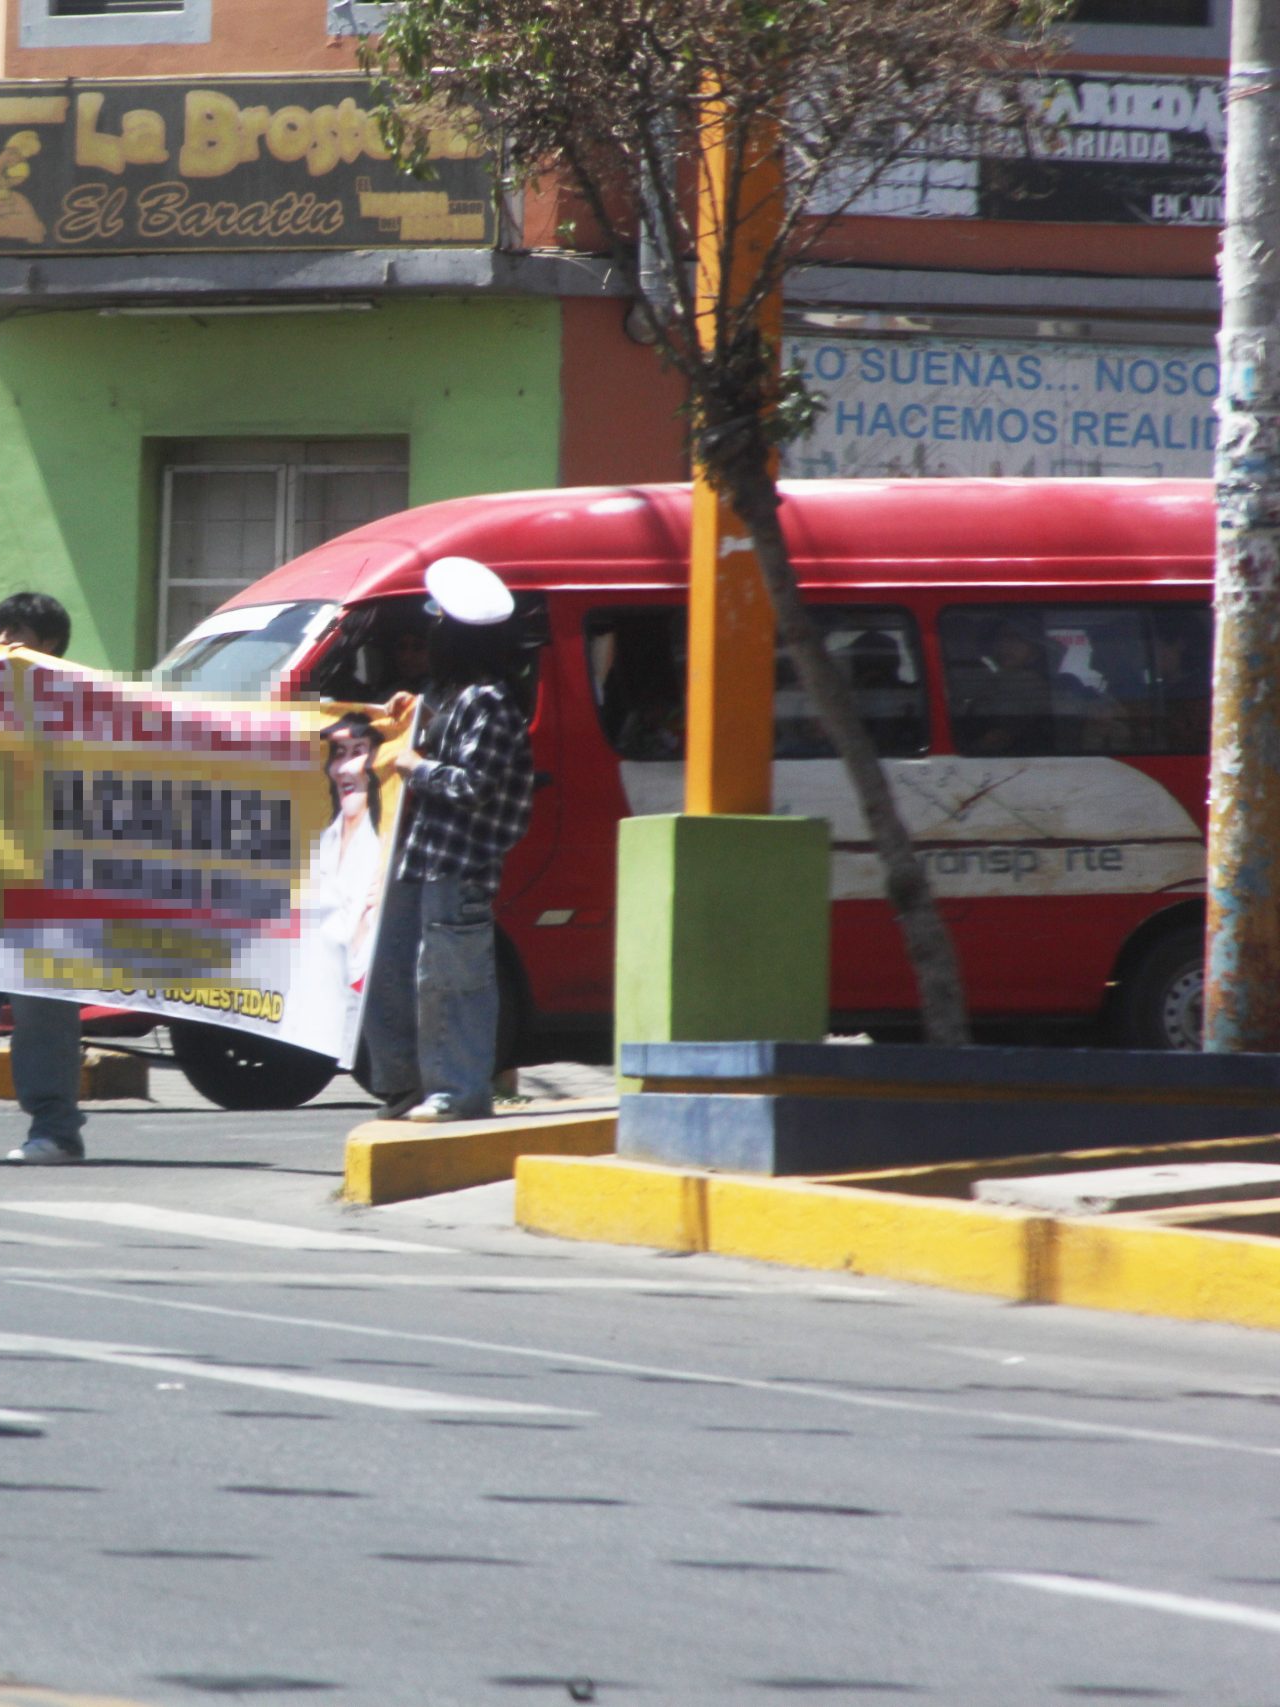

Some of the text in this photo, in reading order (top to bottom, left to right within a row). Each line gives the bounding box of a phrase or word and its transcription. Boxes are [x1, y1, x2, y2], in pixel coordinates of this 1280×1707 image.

[75, 92, 168, 174] La
[54, 182, 126, 243] El
[135, 180, 345, 240] Baratin
[860, 345, 1080, 392] SUEÑAS...
[1096, 357, 1220, 397] NOSO
[835, 403, 1058, 445] HACEMOS
